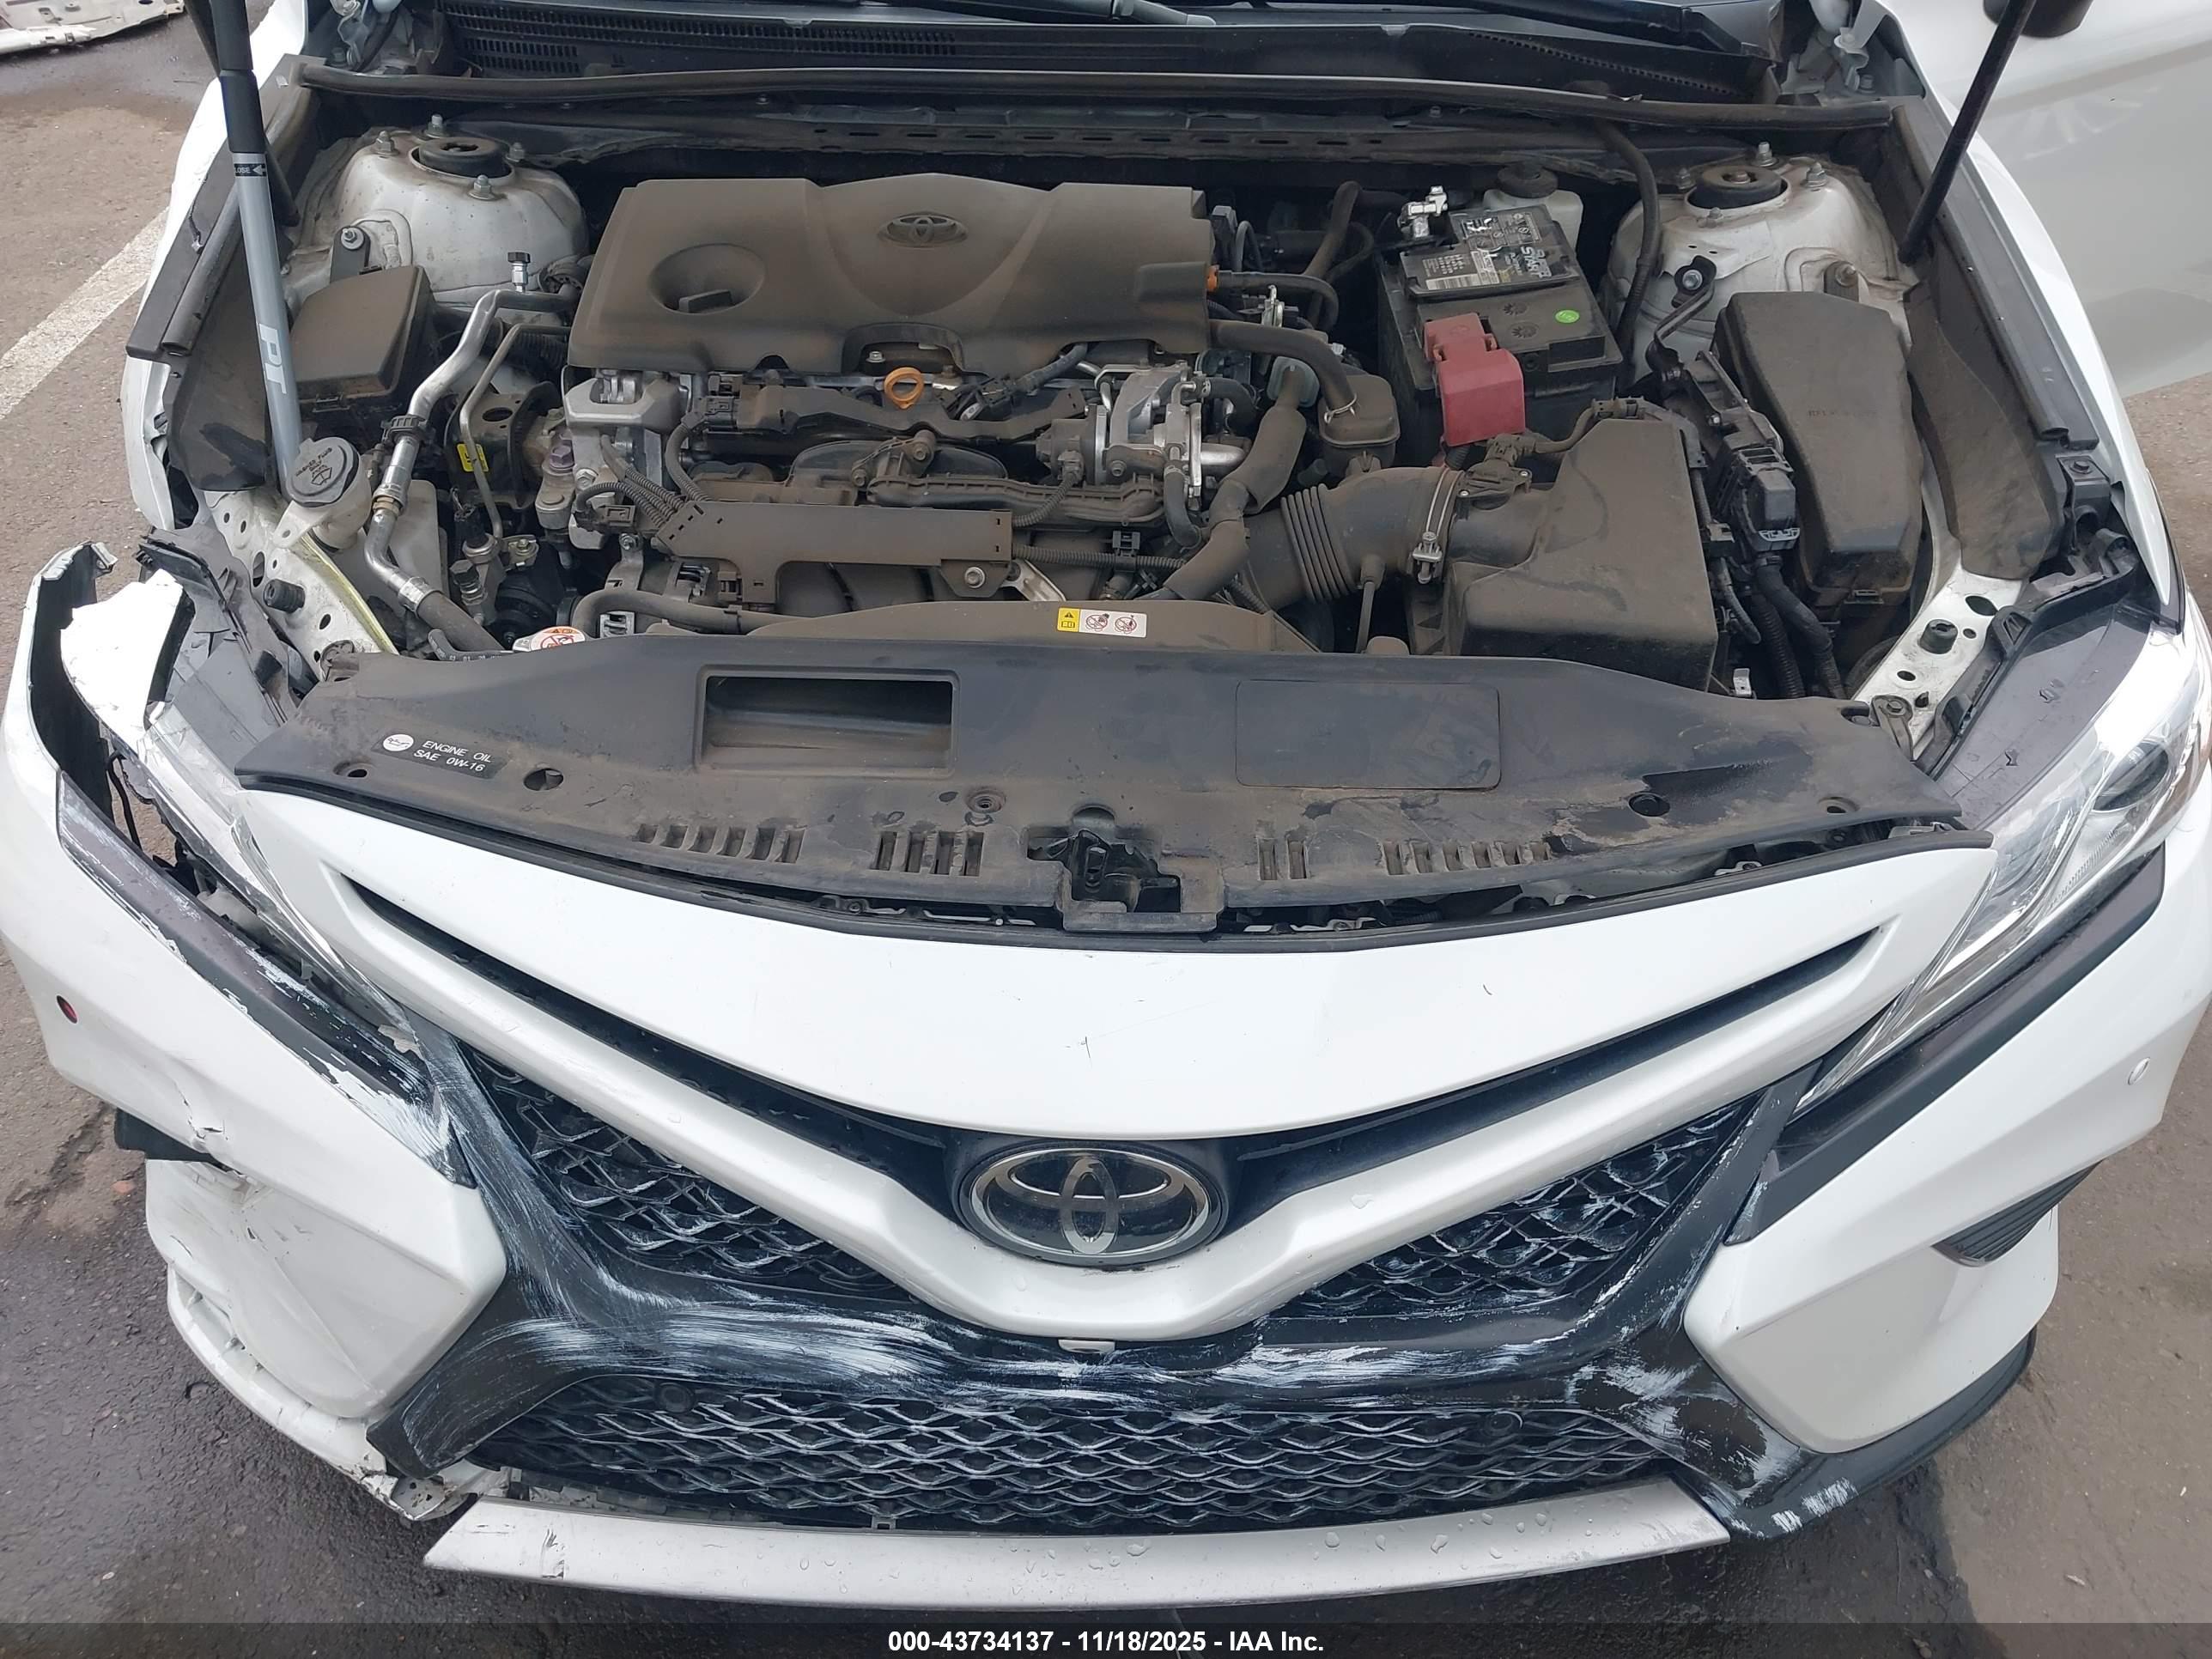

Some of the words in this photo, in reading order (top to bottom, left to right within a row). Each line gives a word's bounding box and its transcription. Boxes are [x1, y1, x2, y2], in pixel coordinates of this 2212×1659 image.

[413, 749, 441, 762] SAE
[446, 757, 486, 772] 0W-16
[422, 740, 470, 757] ENGINE
[473, 752, 493, 763] OIL
